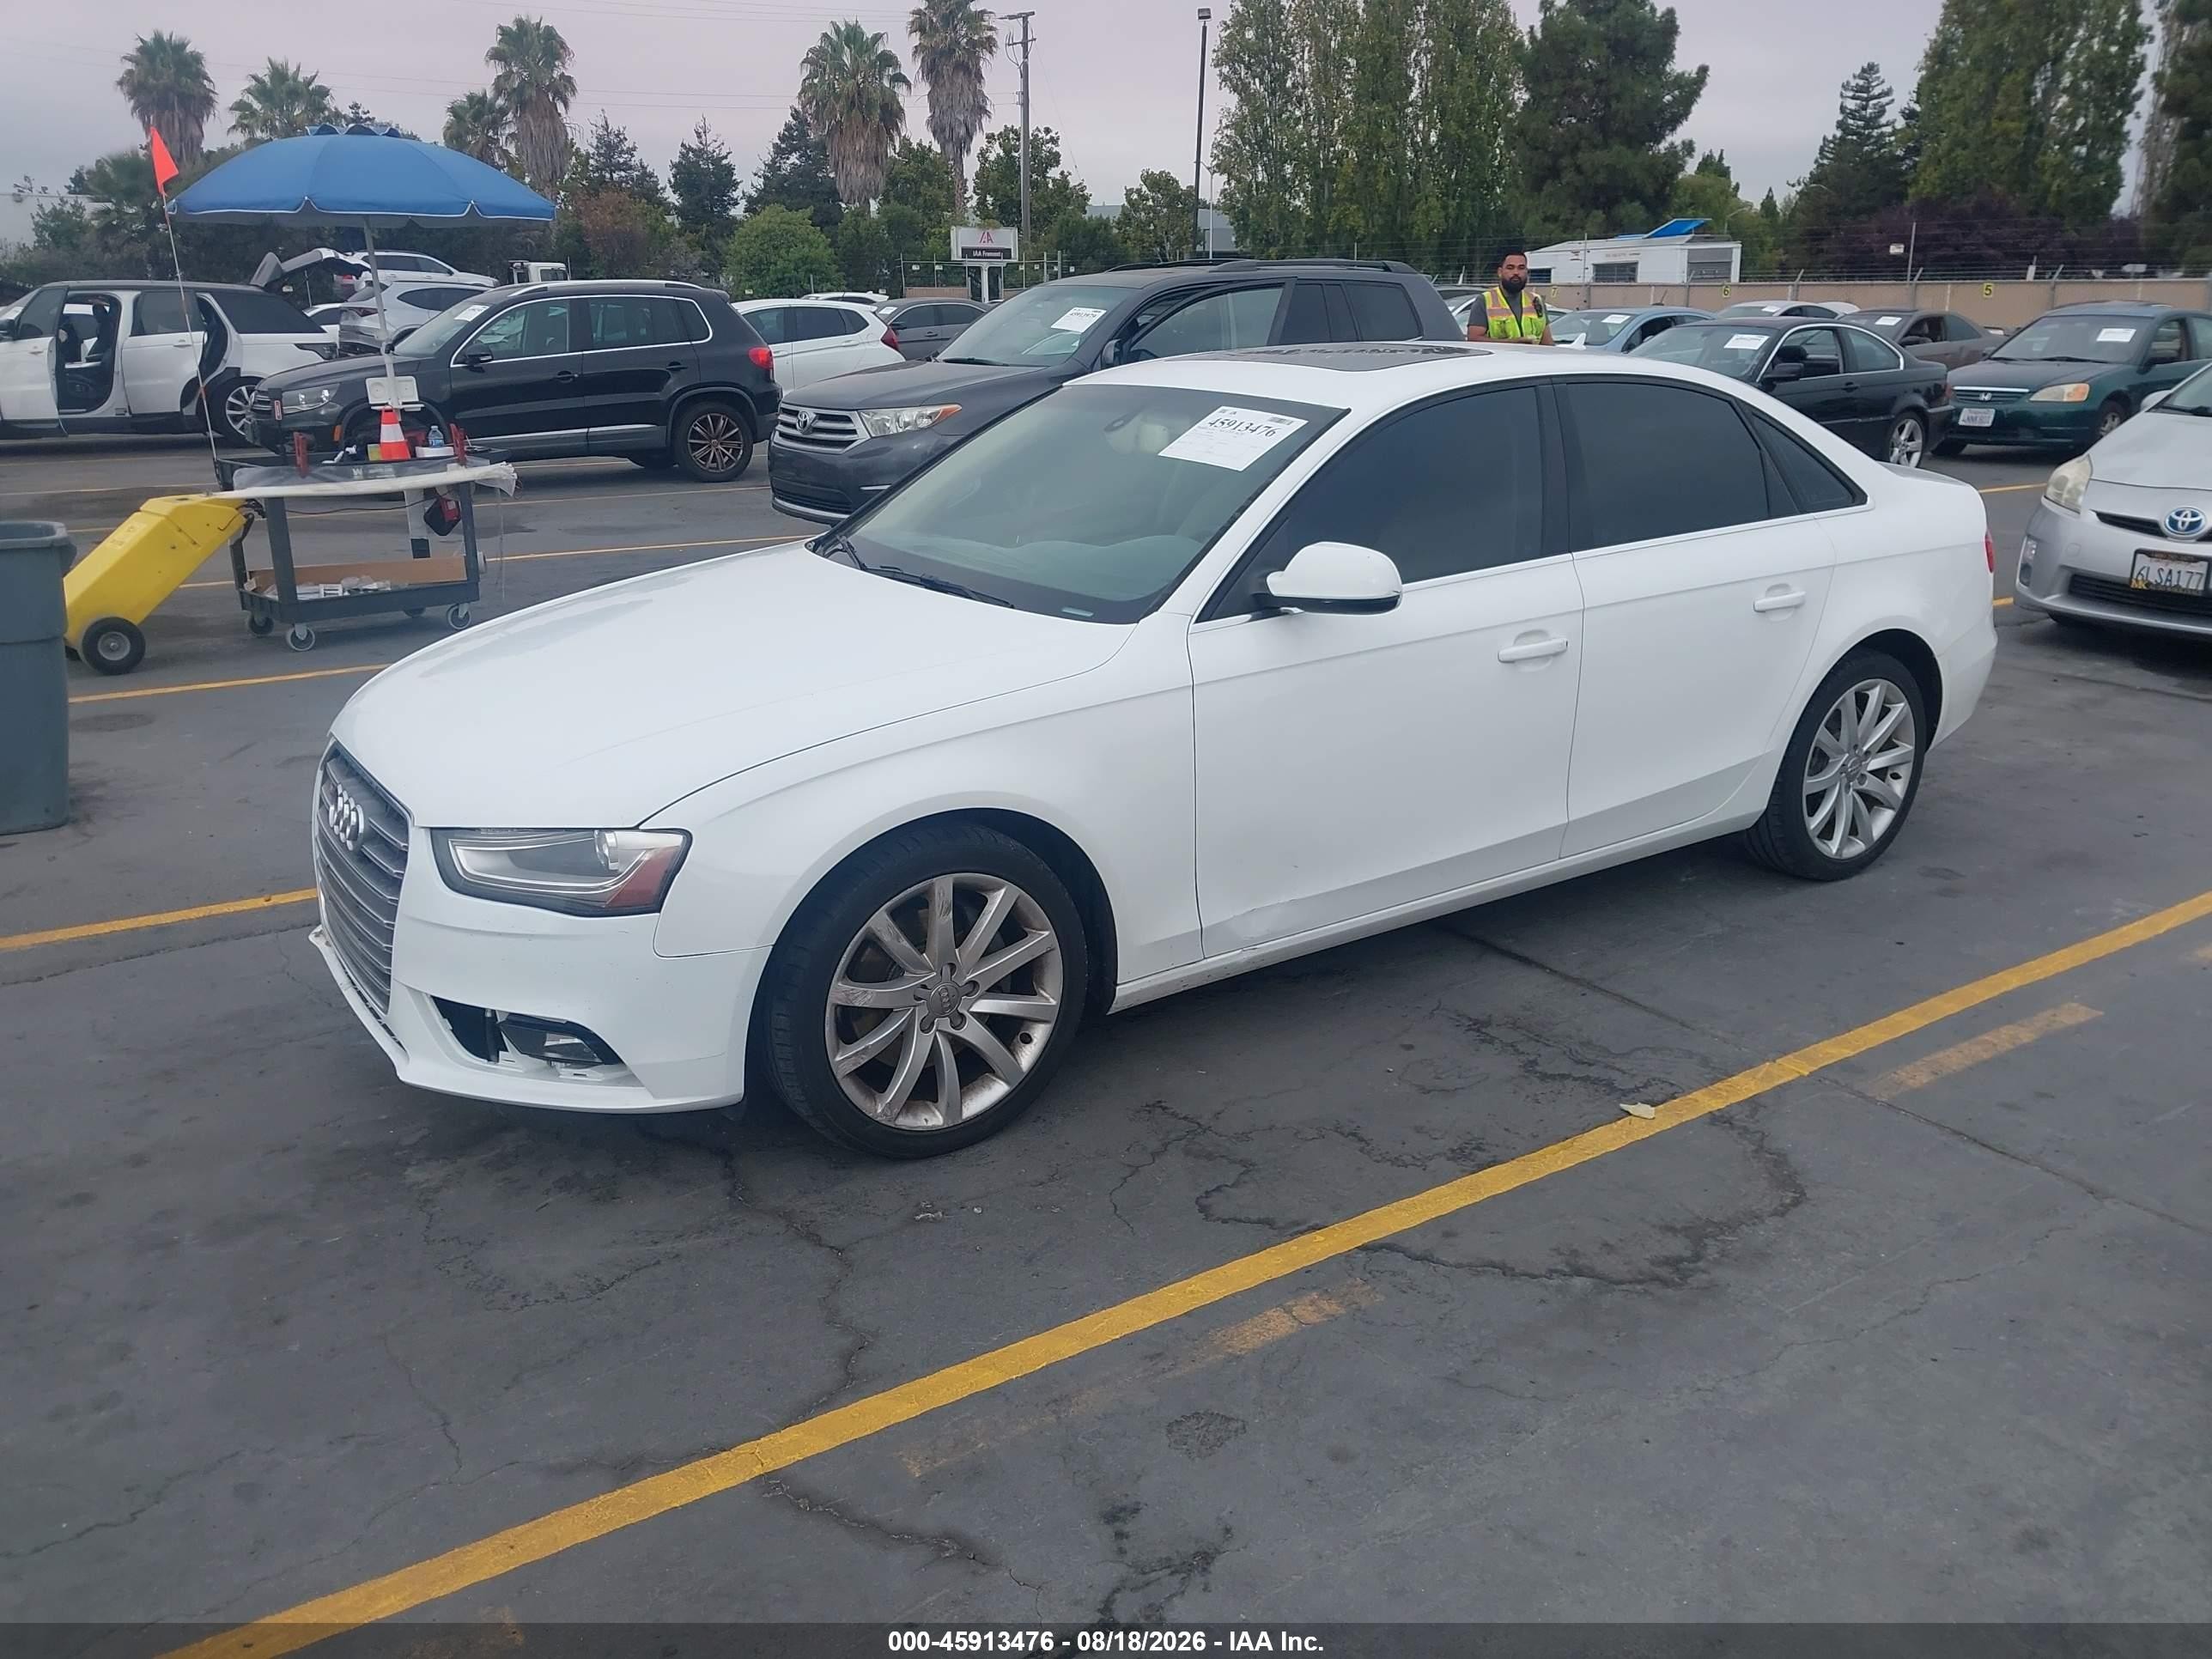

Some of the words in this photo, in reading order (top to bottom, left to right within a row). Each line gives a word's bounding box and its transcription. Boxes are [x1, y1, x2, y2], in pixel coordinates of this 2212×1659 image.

[1723, 285, 1729, 296] 6
[1984, 284, 1992, 296] 5
[1208, 417, 1282, 437] 45913476
